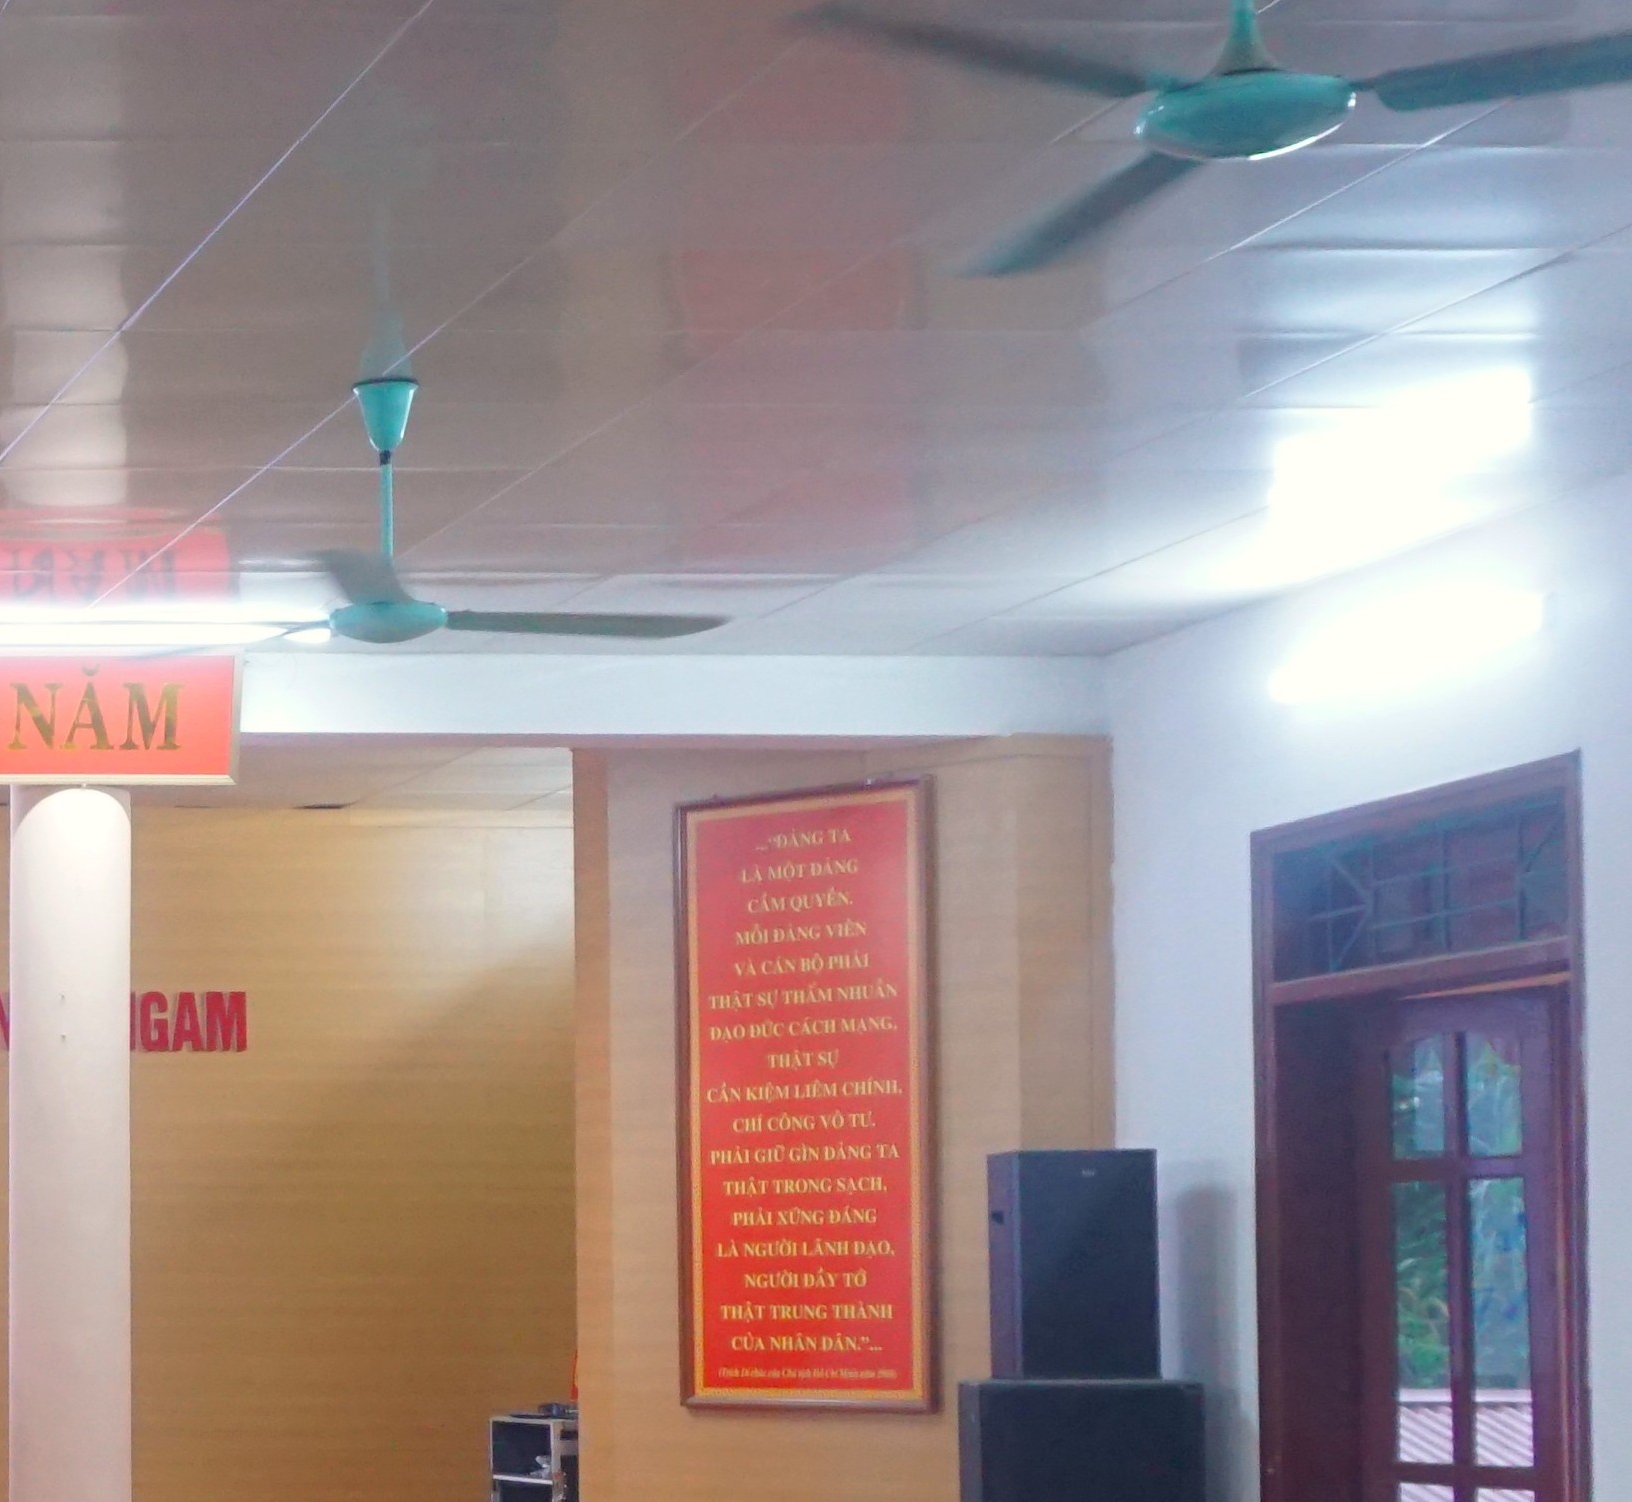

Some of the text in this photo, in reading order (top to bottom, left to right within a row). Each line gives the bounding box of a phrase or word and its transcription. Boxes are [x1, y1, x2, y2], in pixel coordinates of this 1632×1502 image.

[10, 665, 182, 752] NĂM
[828, 827, 851, 843] TA
[741, 857, 858, 883] LÀ MỘT ĐẢNG
[748, 892, 785, 913] CẦM
[736, 918, 866, 945] MỖI ĐẢNG VIÊN
[734, 950, 869, 976] VÀ CÁN BỘ PHẢI
[710, 978, 897, 1011] THẬT SỰ THẤM NHUẦN
[130, 991, 248, 1052] GAM
[710, 1024, 745, 1043] ĐẠO
[749, 1019, 784, 1038] ĐỨC
[788, 1017, 836, 1036] CÁCH
[767, 1048, 839, 1070] THẬT SỰ
[706, 1081, 740, 1103] CẦN
[746, 1082, 789, 1103] KIỆM
[794, 1079, 838, 1099] LIÊM
[732, 1114, 762, 1133] CHÍ
[767, 1112, 815, 1131] CÔNG
[820, 1109, 844, 1129] VÔ
[710, 1141, 899, 1165] PHẢI GIỮ GÌN ĐẢNG TA
[723, 1176, 768, 1197] THẬT
[773, 1177, 832, 1194] TRONG
[733, 1205, 877, 1227] PHẢI XỨNG ĐÁNG
[717, 1239, 739, 1258] LÀ
[743, 1238, 797, 1258] NGƯỜI
[802, 1238, 849, 1256] LÃNH
[744, 1270, 799, 1288] NGƯỜI
[803, 1266, 837, 1288] ĐẦY
[720, 1301, 893, 1322] THẬT TRUNG THÀNH
[731, 1332, 765, 1351] CỦA
[770, 1332, 816, 1352] NHÂN
